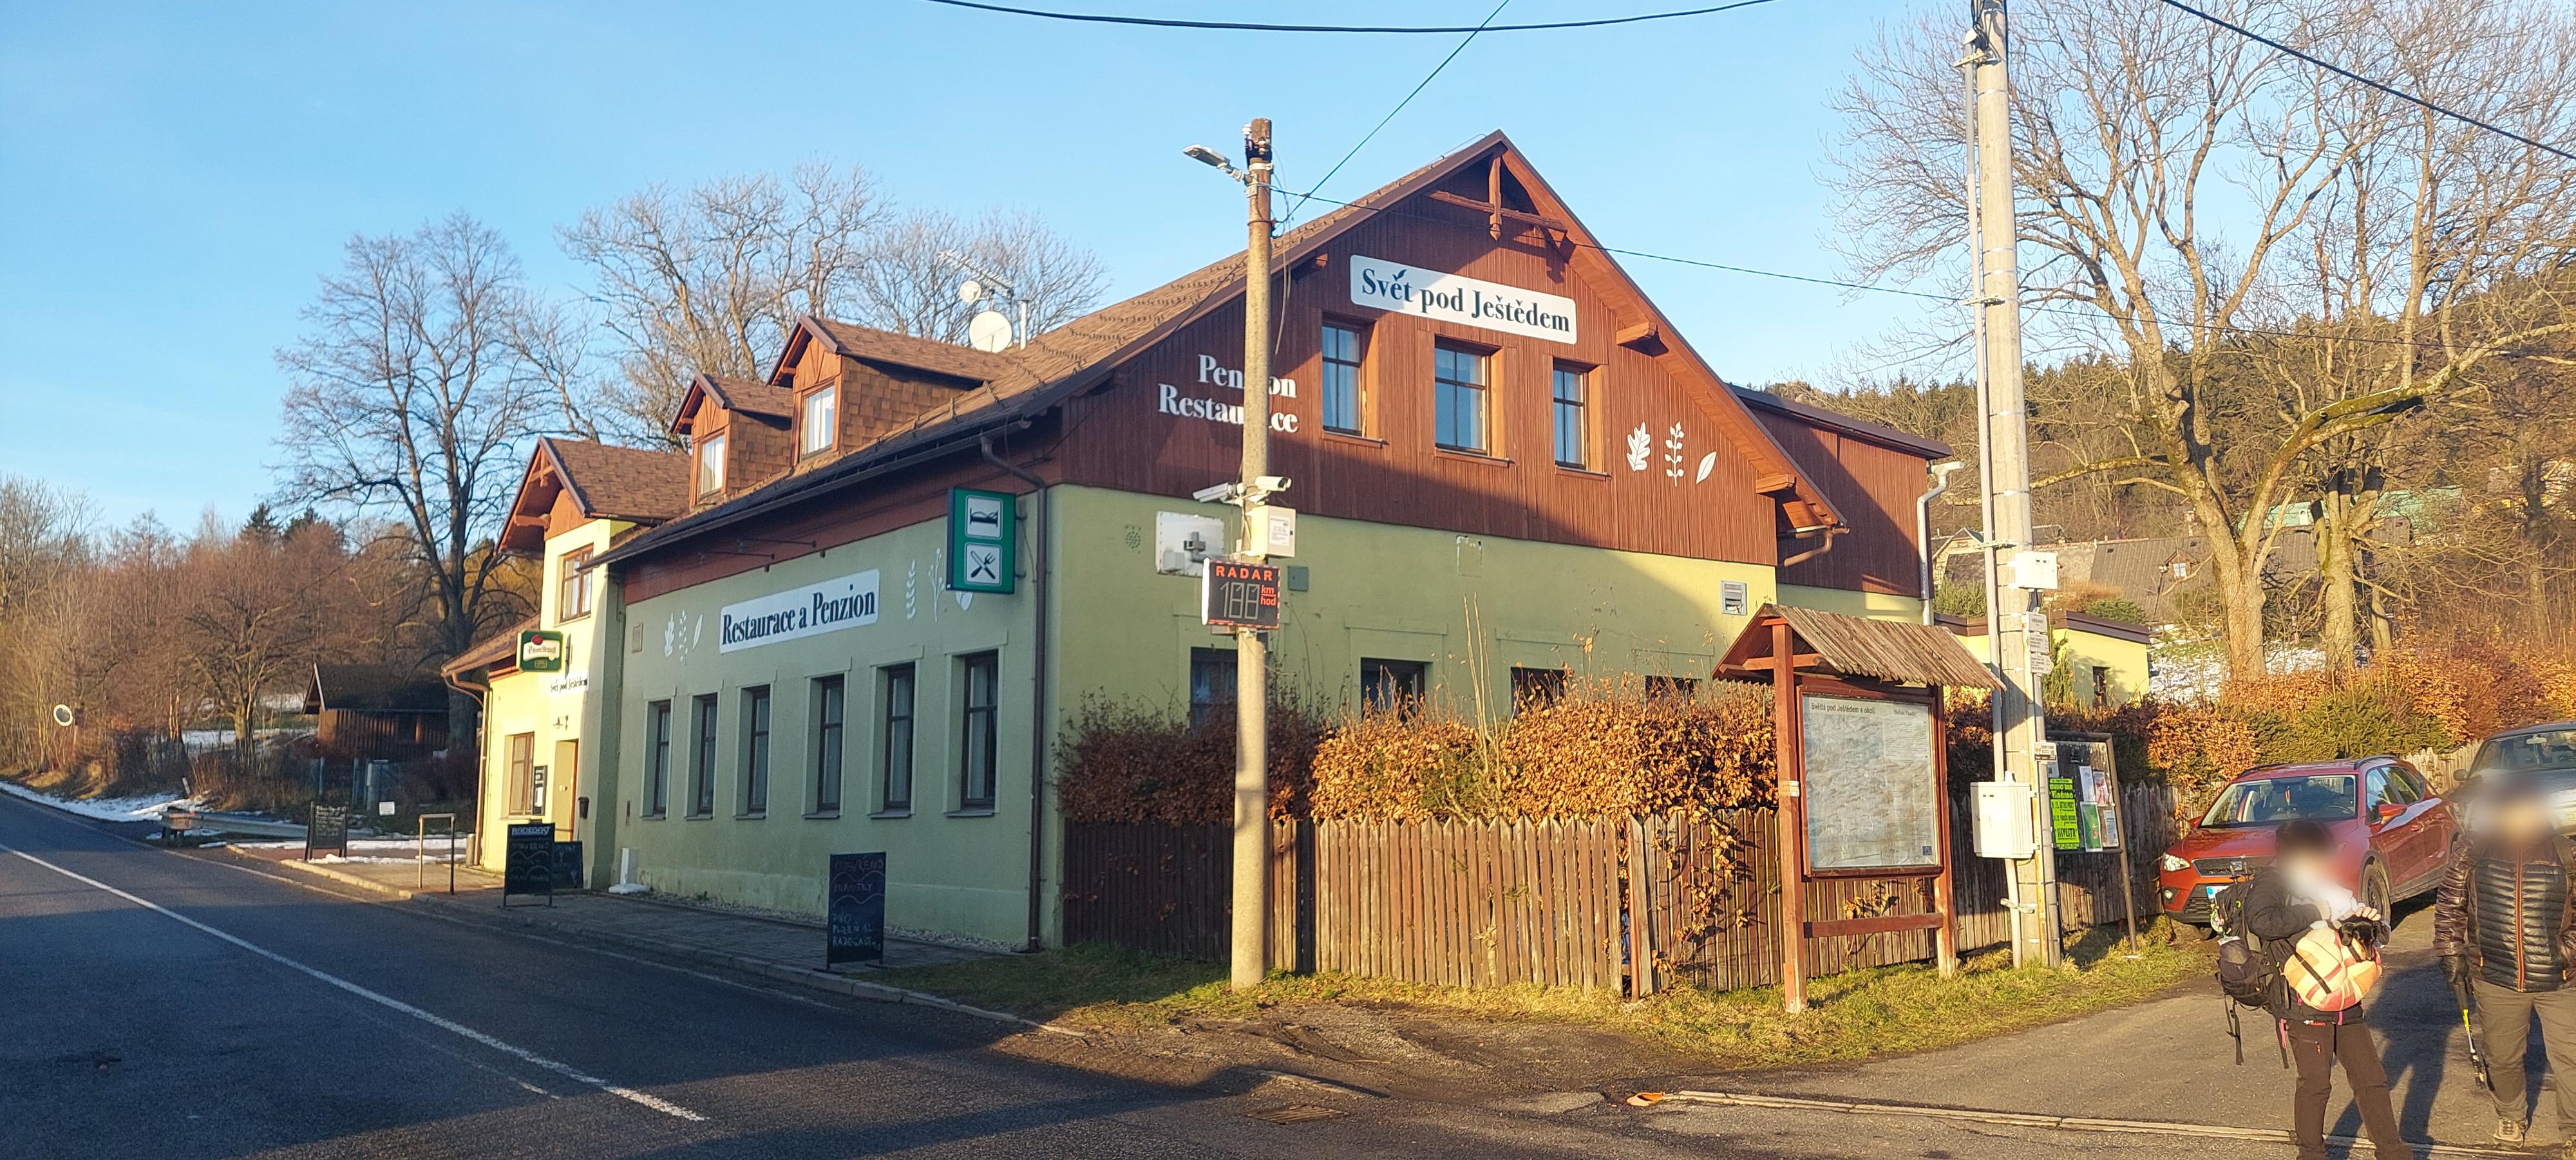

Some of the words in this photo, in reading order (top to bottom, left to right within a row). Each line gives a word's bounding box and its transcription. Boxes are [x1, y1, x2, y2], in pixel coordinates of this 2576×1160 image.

[1361, 268, 1413, 302] Svět
[1419, 287, 1464, 313] pod
[1471, 290, 1570, 332] Ještědem
[1198, 354, 1297, 398] Penon
[1158, 383, 1298, 433] Restauce
[1216, 565, 1273, 581] RADAR
[1260, 596, 1276, 606] hod
[1261, 585, 1274, 594] km
[722, 609, 795, 645] Restaurace
[799, 607, 808, 628] a
[811, 584, 875, 626] Penzion
[1837, 704, 1859, 713] Ještědem
